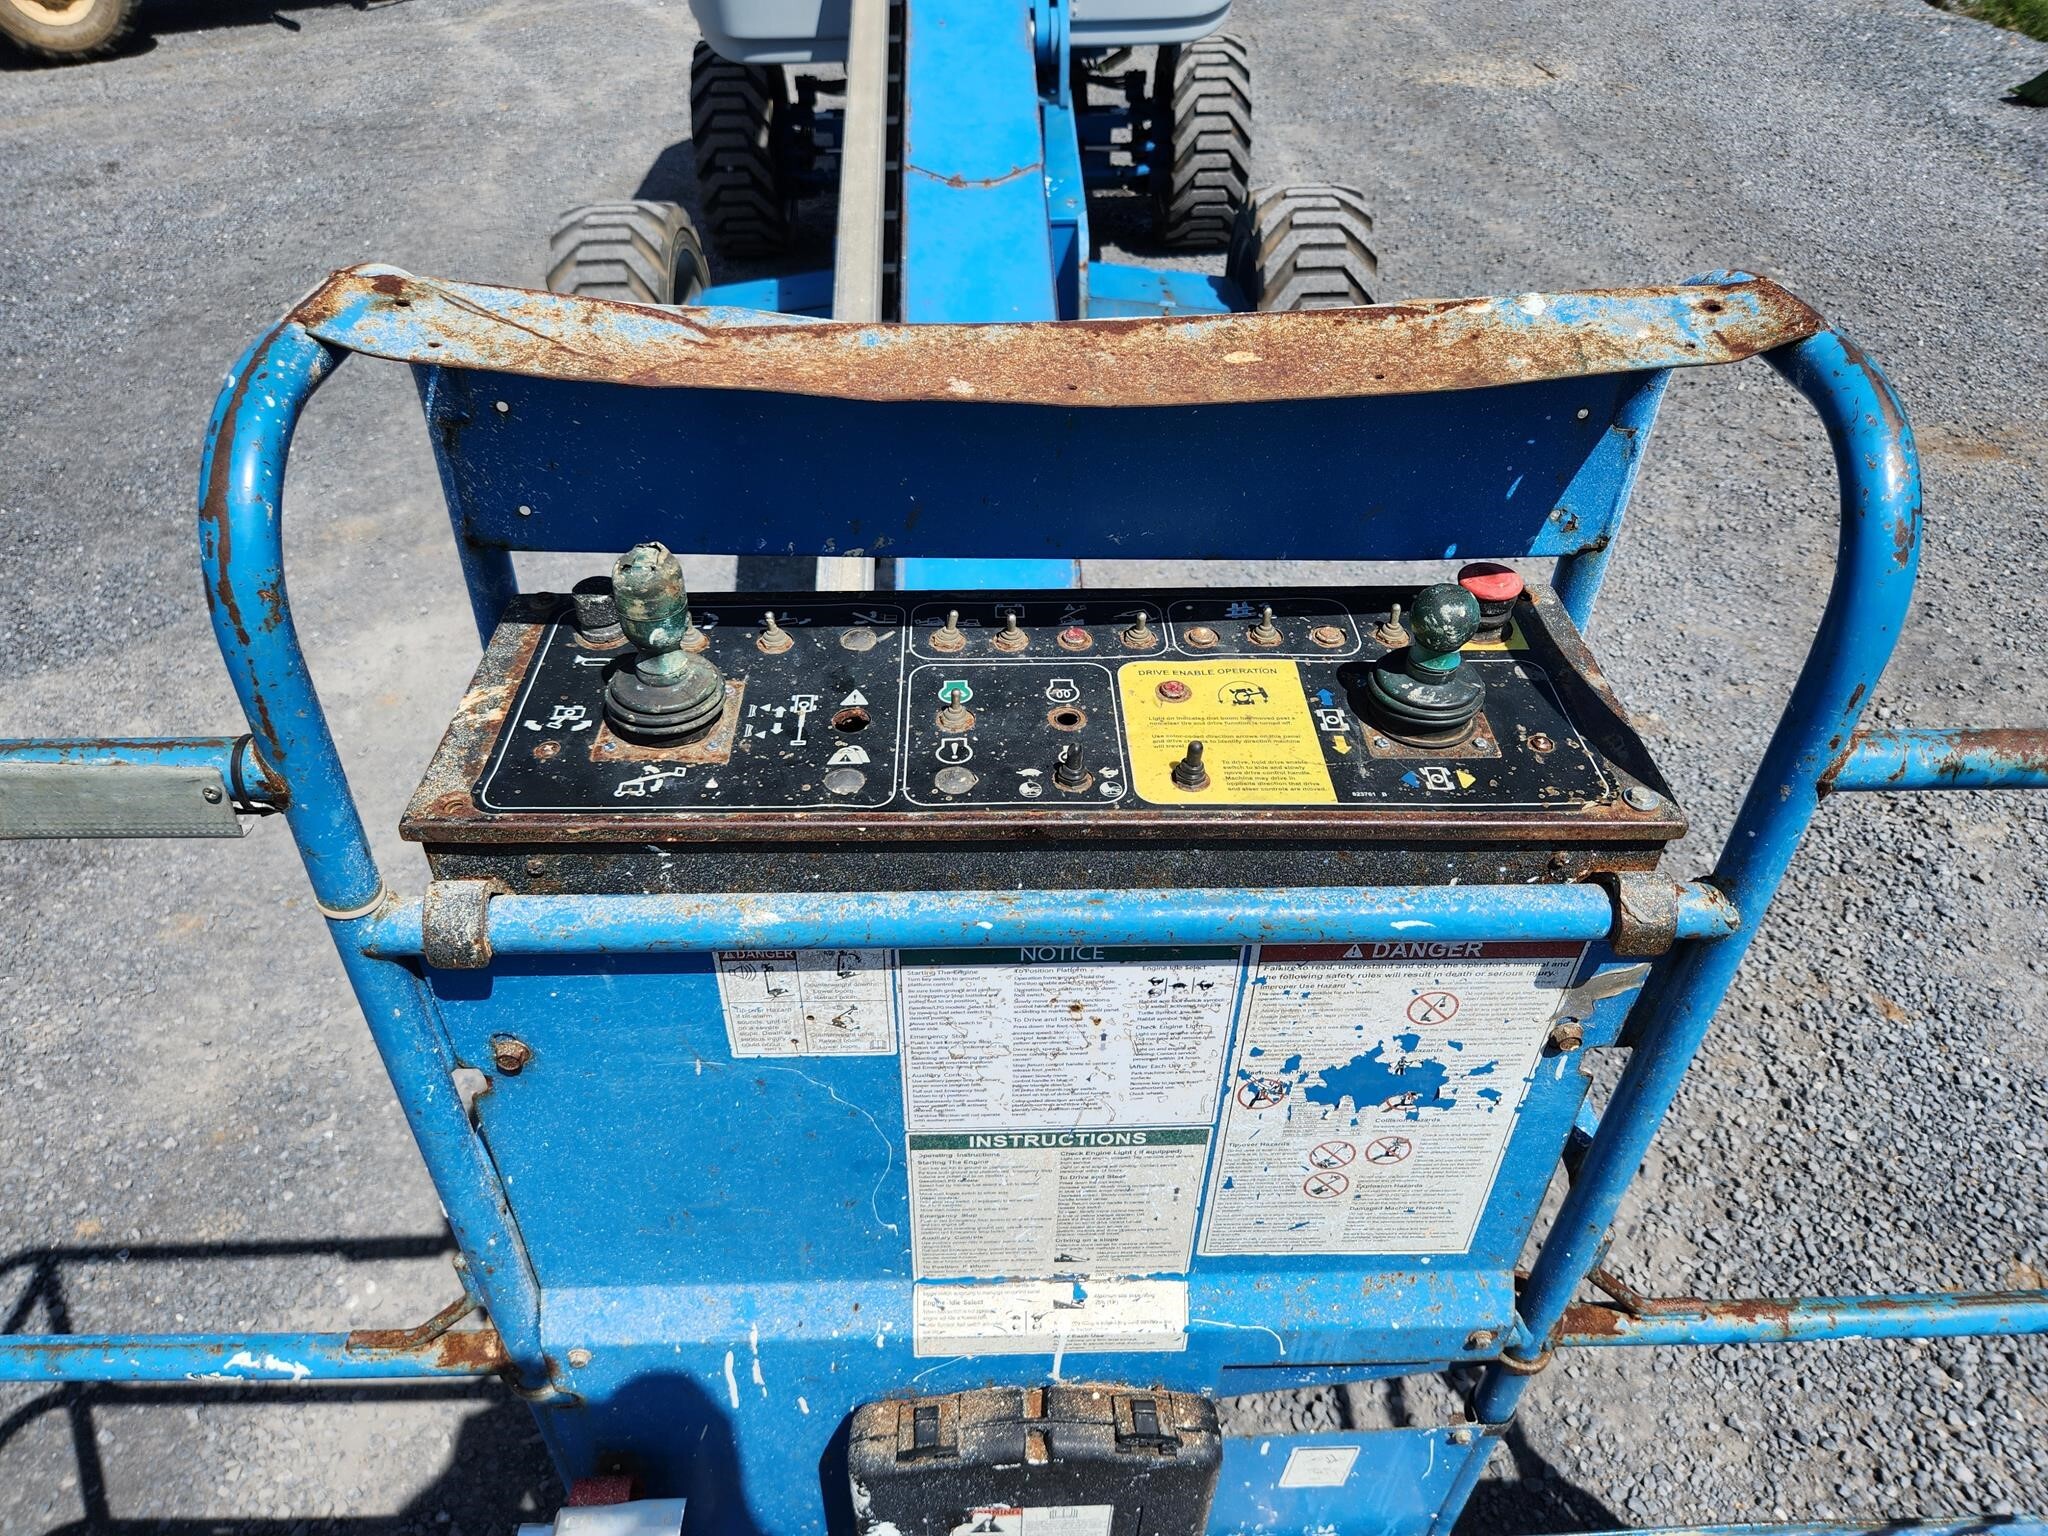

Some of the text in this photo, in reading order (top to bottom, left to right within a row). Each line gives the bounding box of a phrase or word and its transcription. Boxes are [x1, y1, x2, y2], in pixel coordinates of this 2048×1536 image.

[736, 950, 793, 959] DANGER
[1020, 947, 1104, 961] NOTICE
[1372, 942, 1484, 958] DANGER
[969, 1132, 1146, 1148] INSTRUCTIONS
